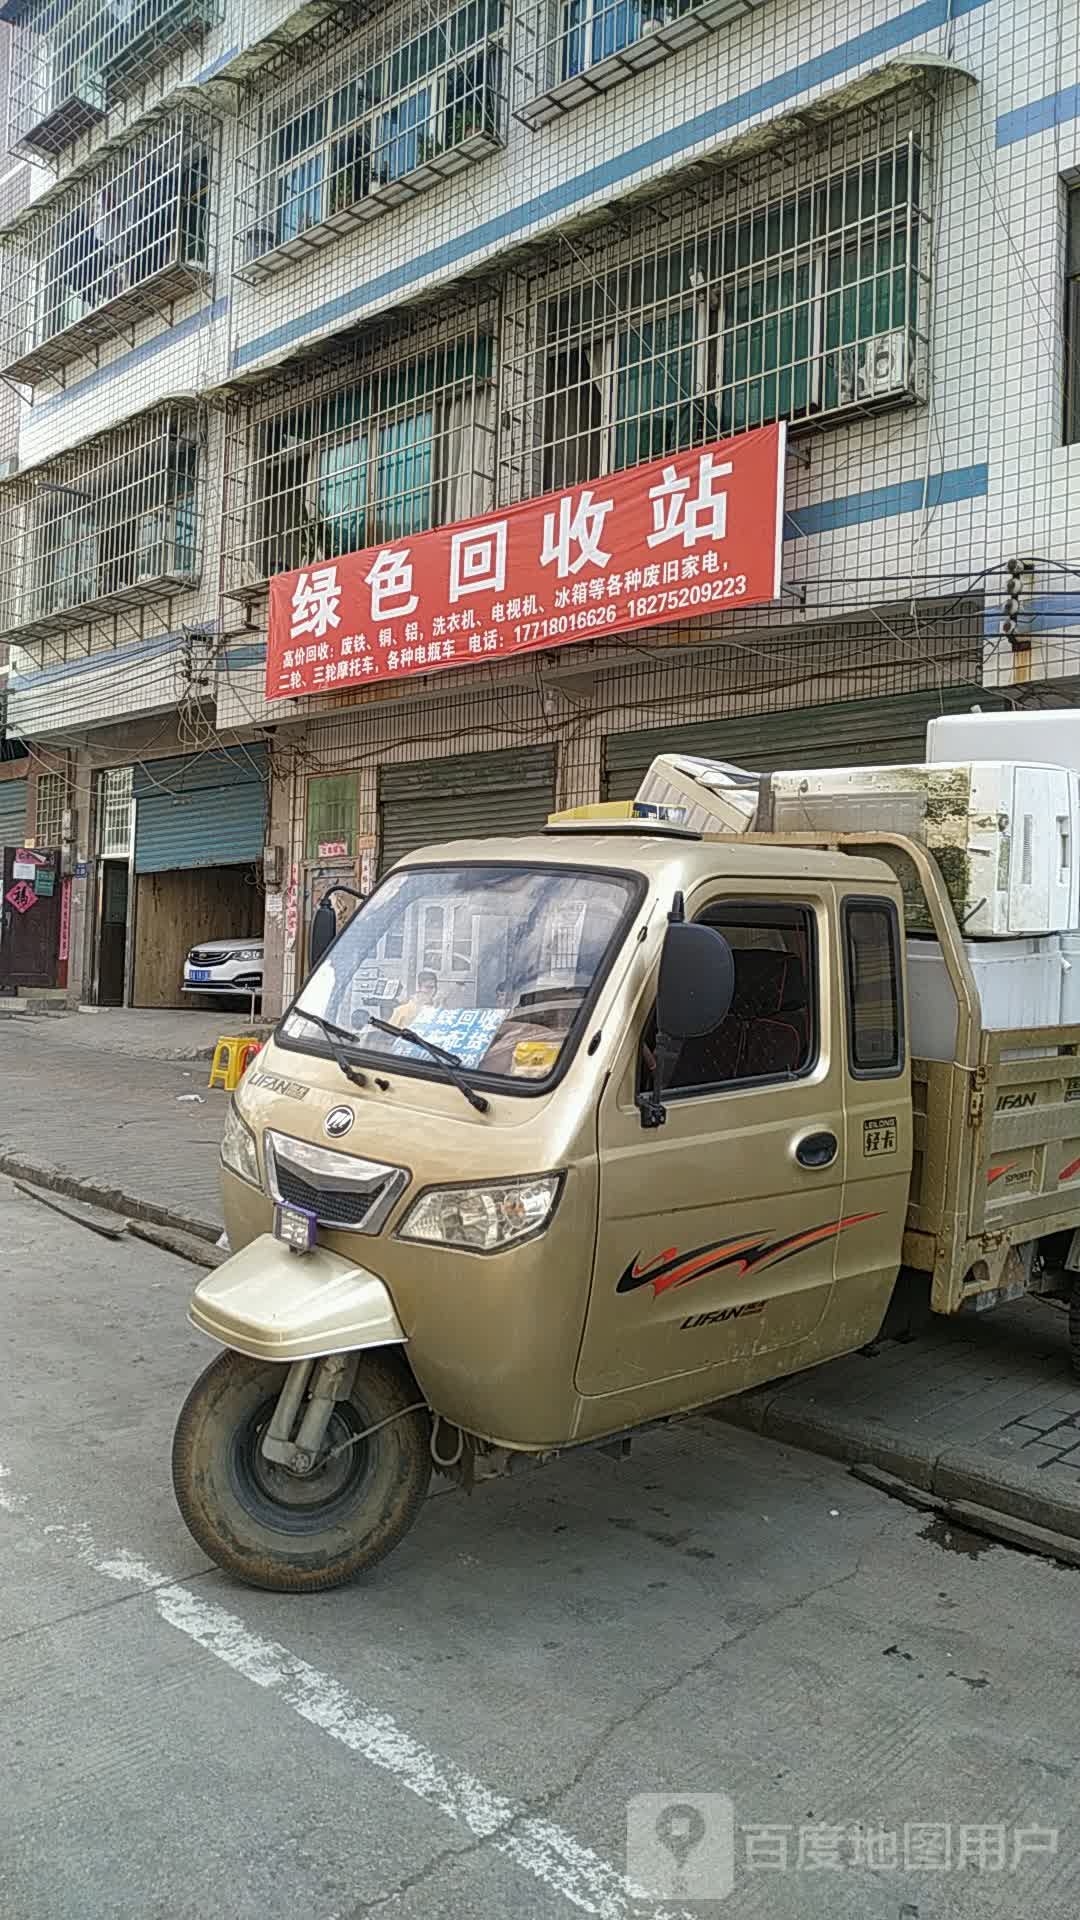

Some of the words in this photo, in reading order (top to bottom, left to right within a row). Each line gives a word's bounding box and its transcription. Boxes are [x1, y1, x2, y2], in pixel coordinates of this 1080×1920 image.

[290, 453, 733, 640] 绿色回收站
[627, 575, 747, 618] 18275209223
[248, 1072, 291, 1095] LIFAN
[866, 1130, 895, 1152] 轻卡
[680, 1305, 746, 1329] LIFAN
